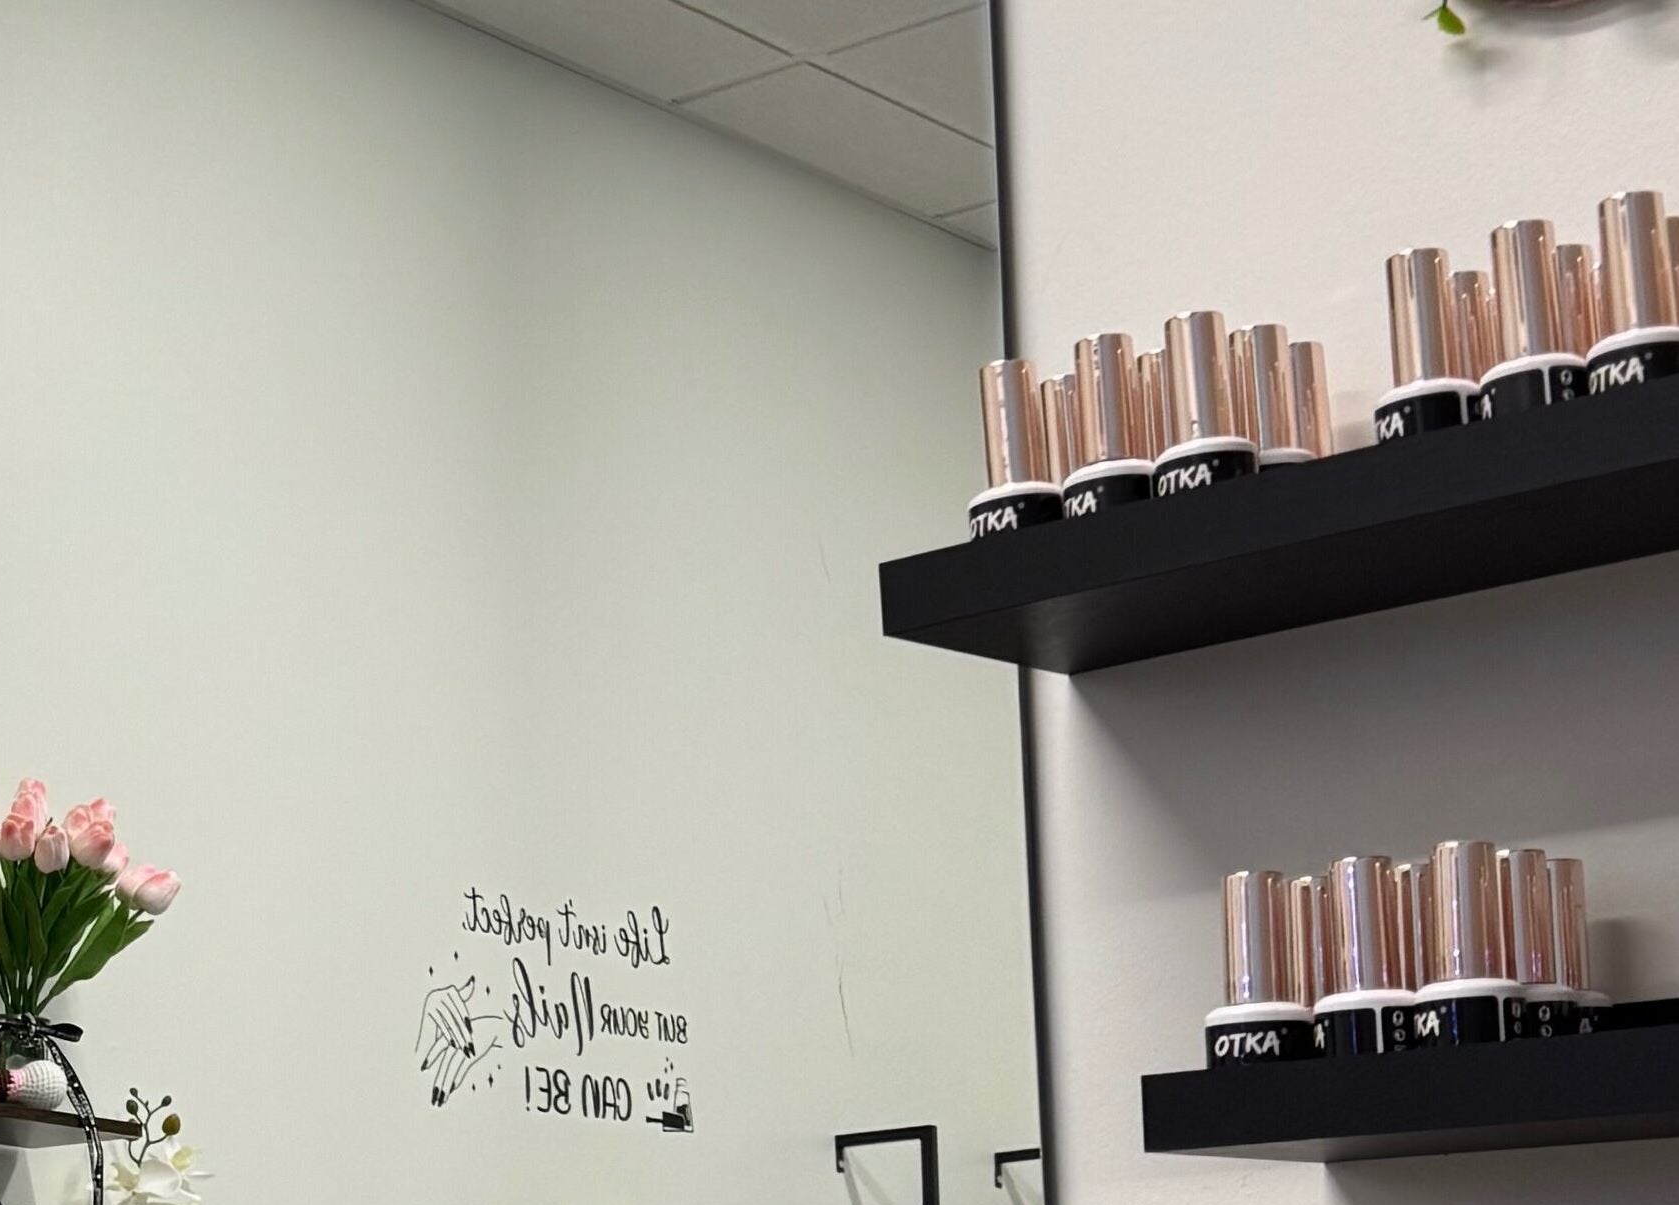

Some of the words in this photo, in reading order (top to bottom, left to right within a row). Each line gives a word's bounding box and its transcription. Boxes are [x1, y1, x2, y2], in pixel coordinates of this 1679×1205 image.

[1588, 356, 1645, 396] OTKA
[1156, 463, 1213, 498] OTKA
[1064, 490, 1097, 520] TKA
[1214, 1030, 1281, 1057] OTKA
